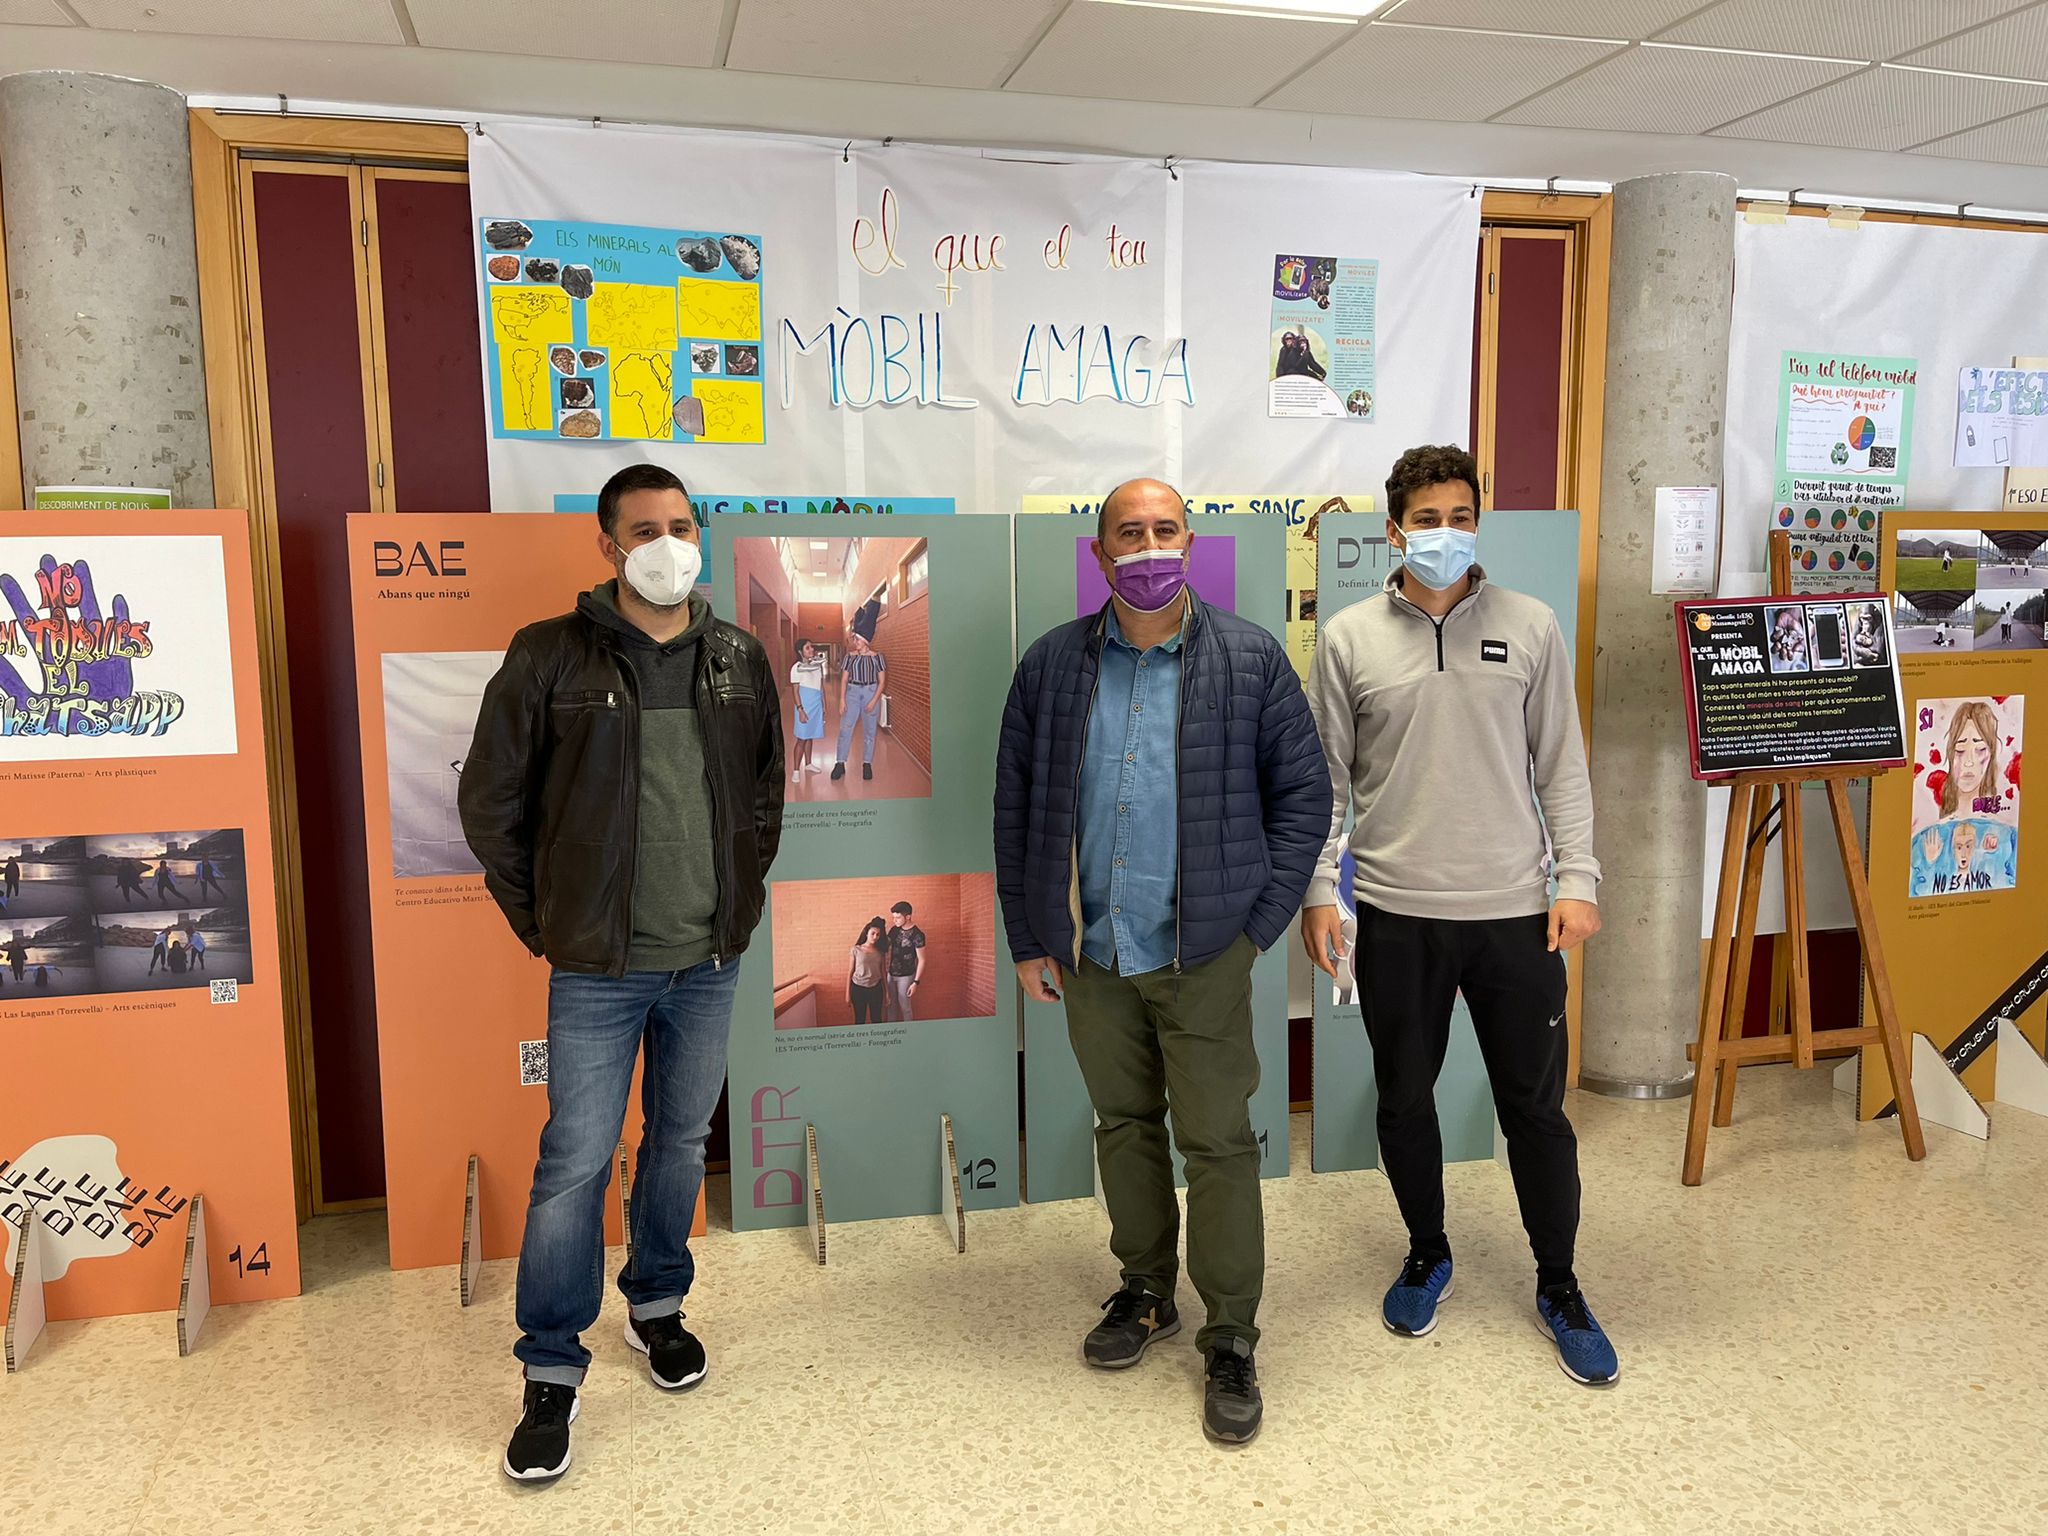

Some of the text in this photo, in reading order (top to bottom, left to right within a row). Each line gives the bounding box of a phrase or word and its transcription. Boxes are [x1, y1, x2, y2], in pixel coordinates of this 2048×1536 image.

[556, 230, 676, 257] ELS MINERALS AL
[853, 188, 1148, 306] el que el teu
[593, 256, 621, 274] MÓN
[784, 306, 1193, 404] MÒBIL AMAGA
[2018, 488, 2037, 504] ESO
[39, 500, 150, 511] DESCOBRIMENT DE NOUS
[373, 541, 467, 577] BAE
[35, 563, 83, 610] NO
[1338, 579, 1379, 588] Definir la
[378, 589, 471, 601] Abans que ningú
[23, 607, 153, 668] TOQUES
[1484, 646, 1505, 655] PUMA
[1711, 660, 1765, 676] AMAGA
[43, 660, 90, 696] EL
[1702, 683, 1719, 691] Saps
[1720, 682, 1743, 690] quants
[1744, 680, 1771, 688] minerals
[1788, 678, 1817, 687] presents
[1837, 675, 1859, 683] mòbil?
[1712, 693, 1730, 702] quins
[1730, 692, 1745, 700] llocs
[1782, 689, 1805, 697] troben
[1805, 686, 1852, 696] principalment?
[1704, 704, 1735, 712] Coneixes
[1746, 701, 1773, 709] minerals
[1774, 700, 1784, 708] de
[1784, 700, 1801, 708] sang
[1804, 699, 1816, 707] per
[1817, 698, 1831, 706] què
[1831, 696, 1871, 705] s'anomenen
[1705, 707, 1847, 723] Aprofitem vida útil dels nostres terminals?
[1706, 725, 1743, 734] Contamina
[1752, 722, 1776, 730] telèfon
[1776, 720, 1798, 729] mòbil?
[1787, 730, 1815, 739] respostes
[1821, 729, 1847, 737] aquestes
[1701, 744, 1712, 752] que
[1713, 742, 1734, 750] existeix
[1756, 739, 1783, 748] problema
[1793, 752, 1831, 761] impliquem?
[14, 772, 46, 780] Matisse
[48, 771, 85, 779] (Paterna)
[115, 768, 157, 778] plàstiques
[840, 809, 878, 818] fotografies)
[793, 819, 872, 829] (Torrevella) Fotografia
[1932, 870, 1992, 894] NO ES AMOR
[395, 888, 404, 896] Te
[395, 895, 483, 907] Centro Educativo Martí
[2013, 974, 2042, 1005] CRUSH
[4, 1001, 177, 1019] Las Lagunas (Torrevella) Arts escèniques
[805, 1033, 826, 1041] normal
[870, 1028, 907, 1038] fotografies)
[1959, 1027, 1988, 1058] CRUSH
[824, 1041, 861, 1050] (Torrevella)
[868, 1038, 901, 1047] Fotografia
[751, 1083, 802, 1209] DTR
[962, 1157, 998, 1190] 12
[42, 1172, 108, 1237] BAE
[82, 1176, 148, 1240] BAE
[122, 1185, 188, 1249] BAE
[229, 1242, 271, 1279] 14
